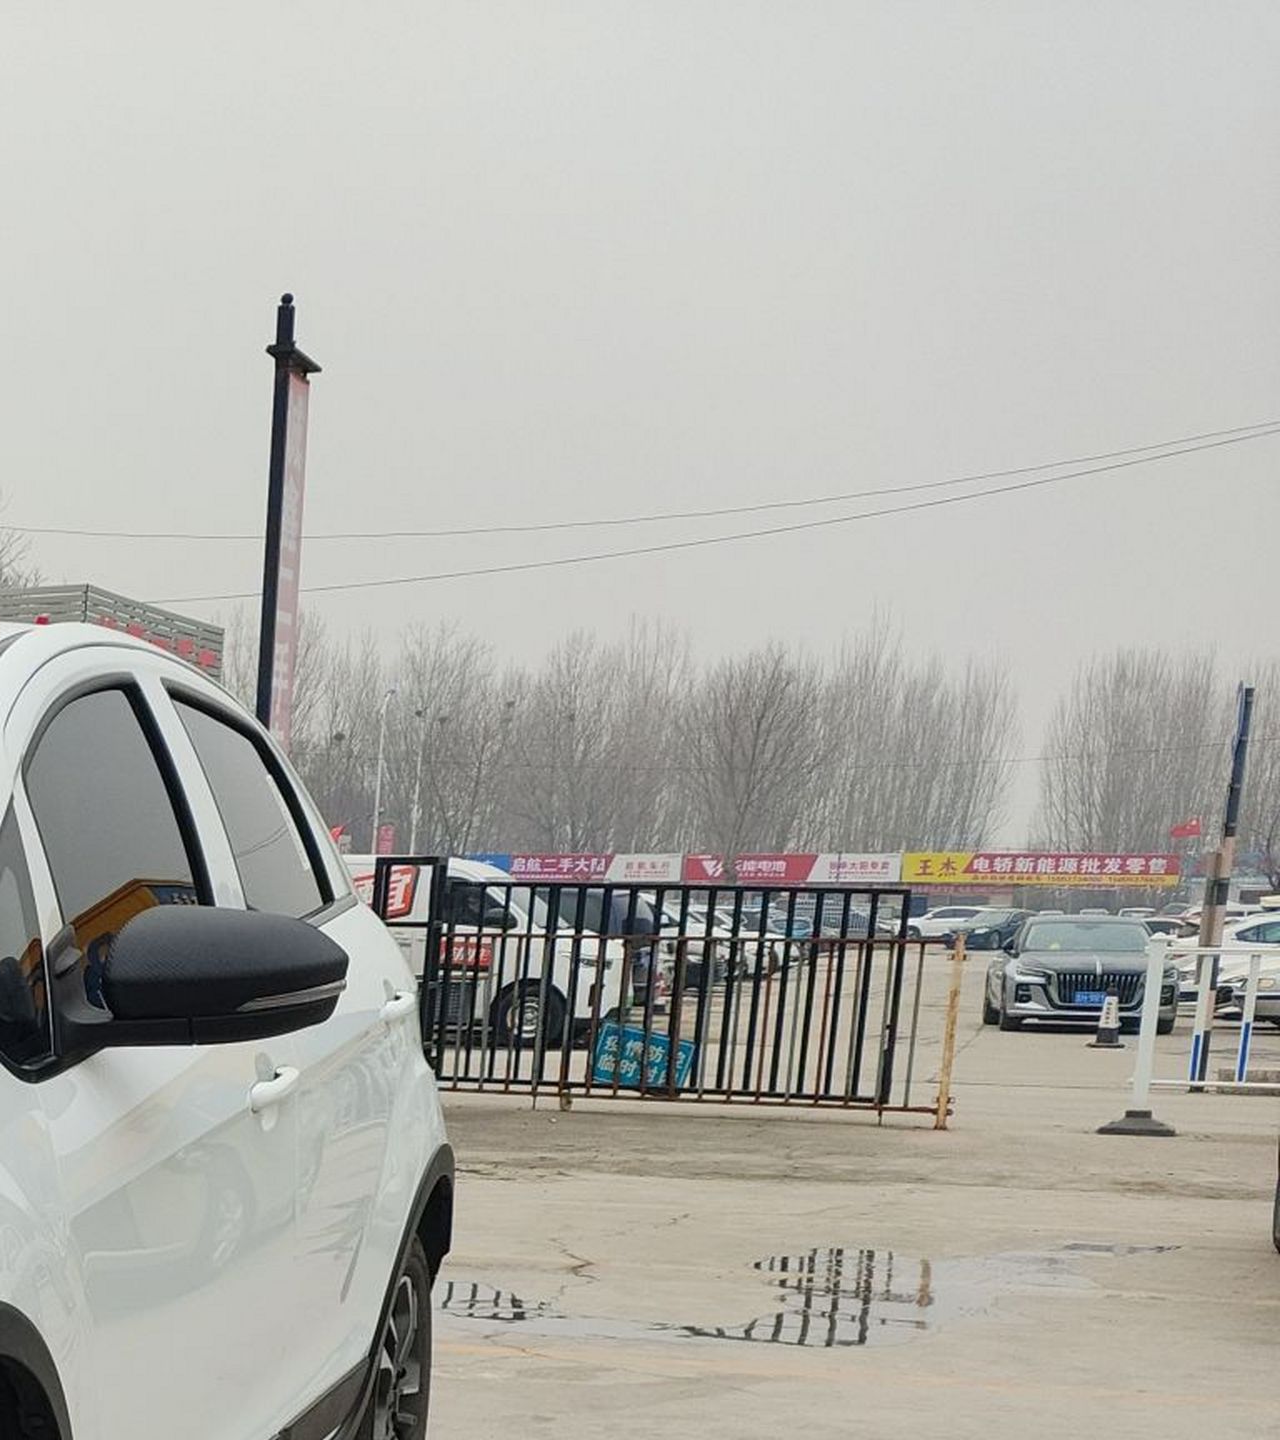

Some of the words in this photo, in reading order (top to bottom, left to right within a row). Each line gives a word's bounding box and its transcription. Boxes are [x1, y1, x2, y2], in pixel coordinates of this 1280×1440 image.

[972, 857, 1168, 874] 电轿新能源批发零售
